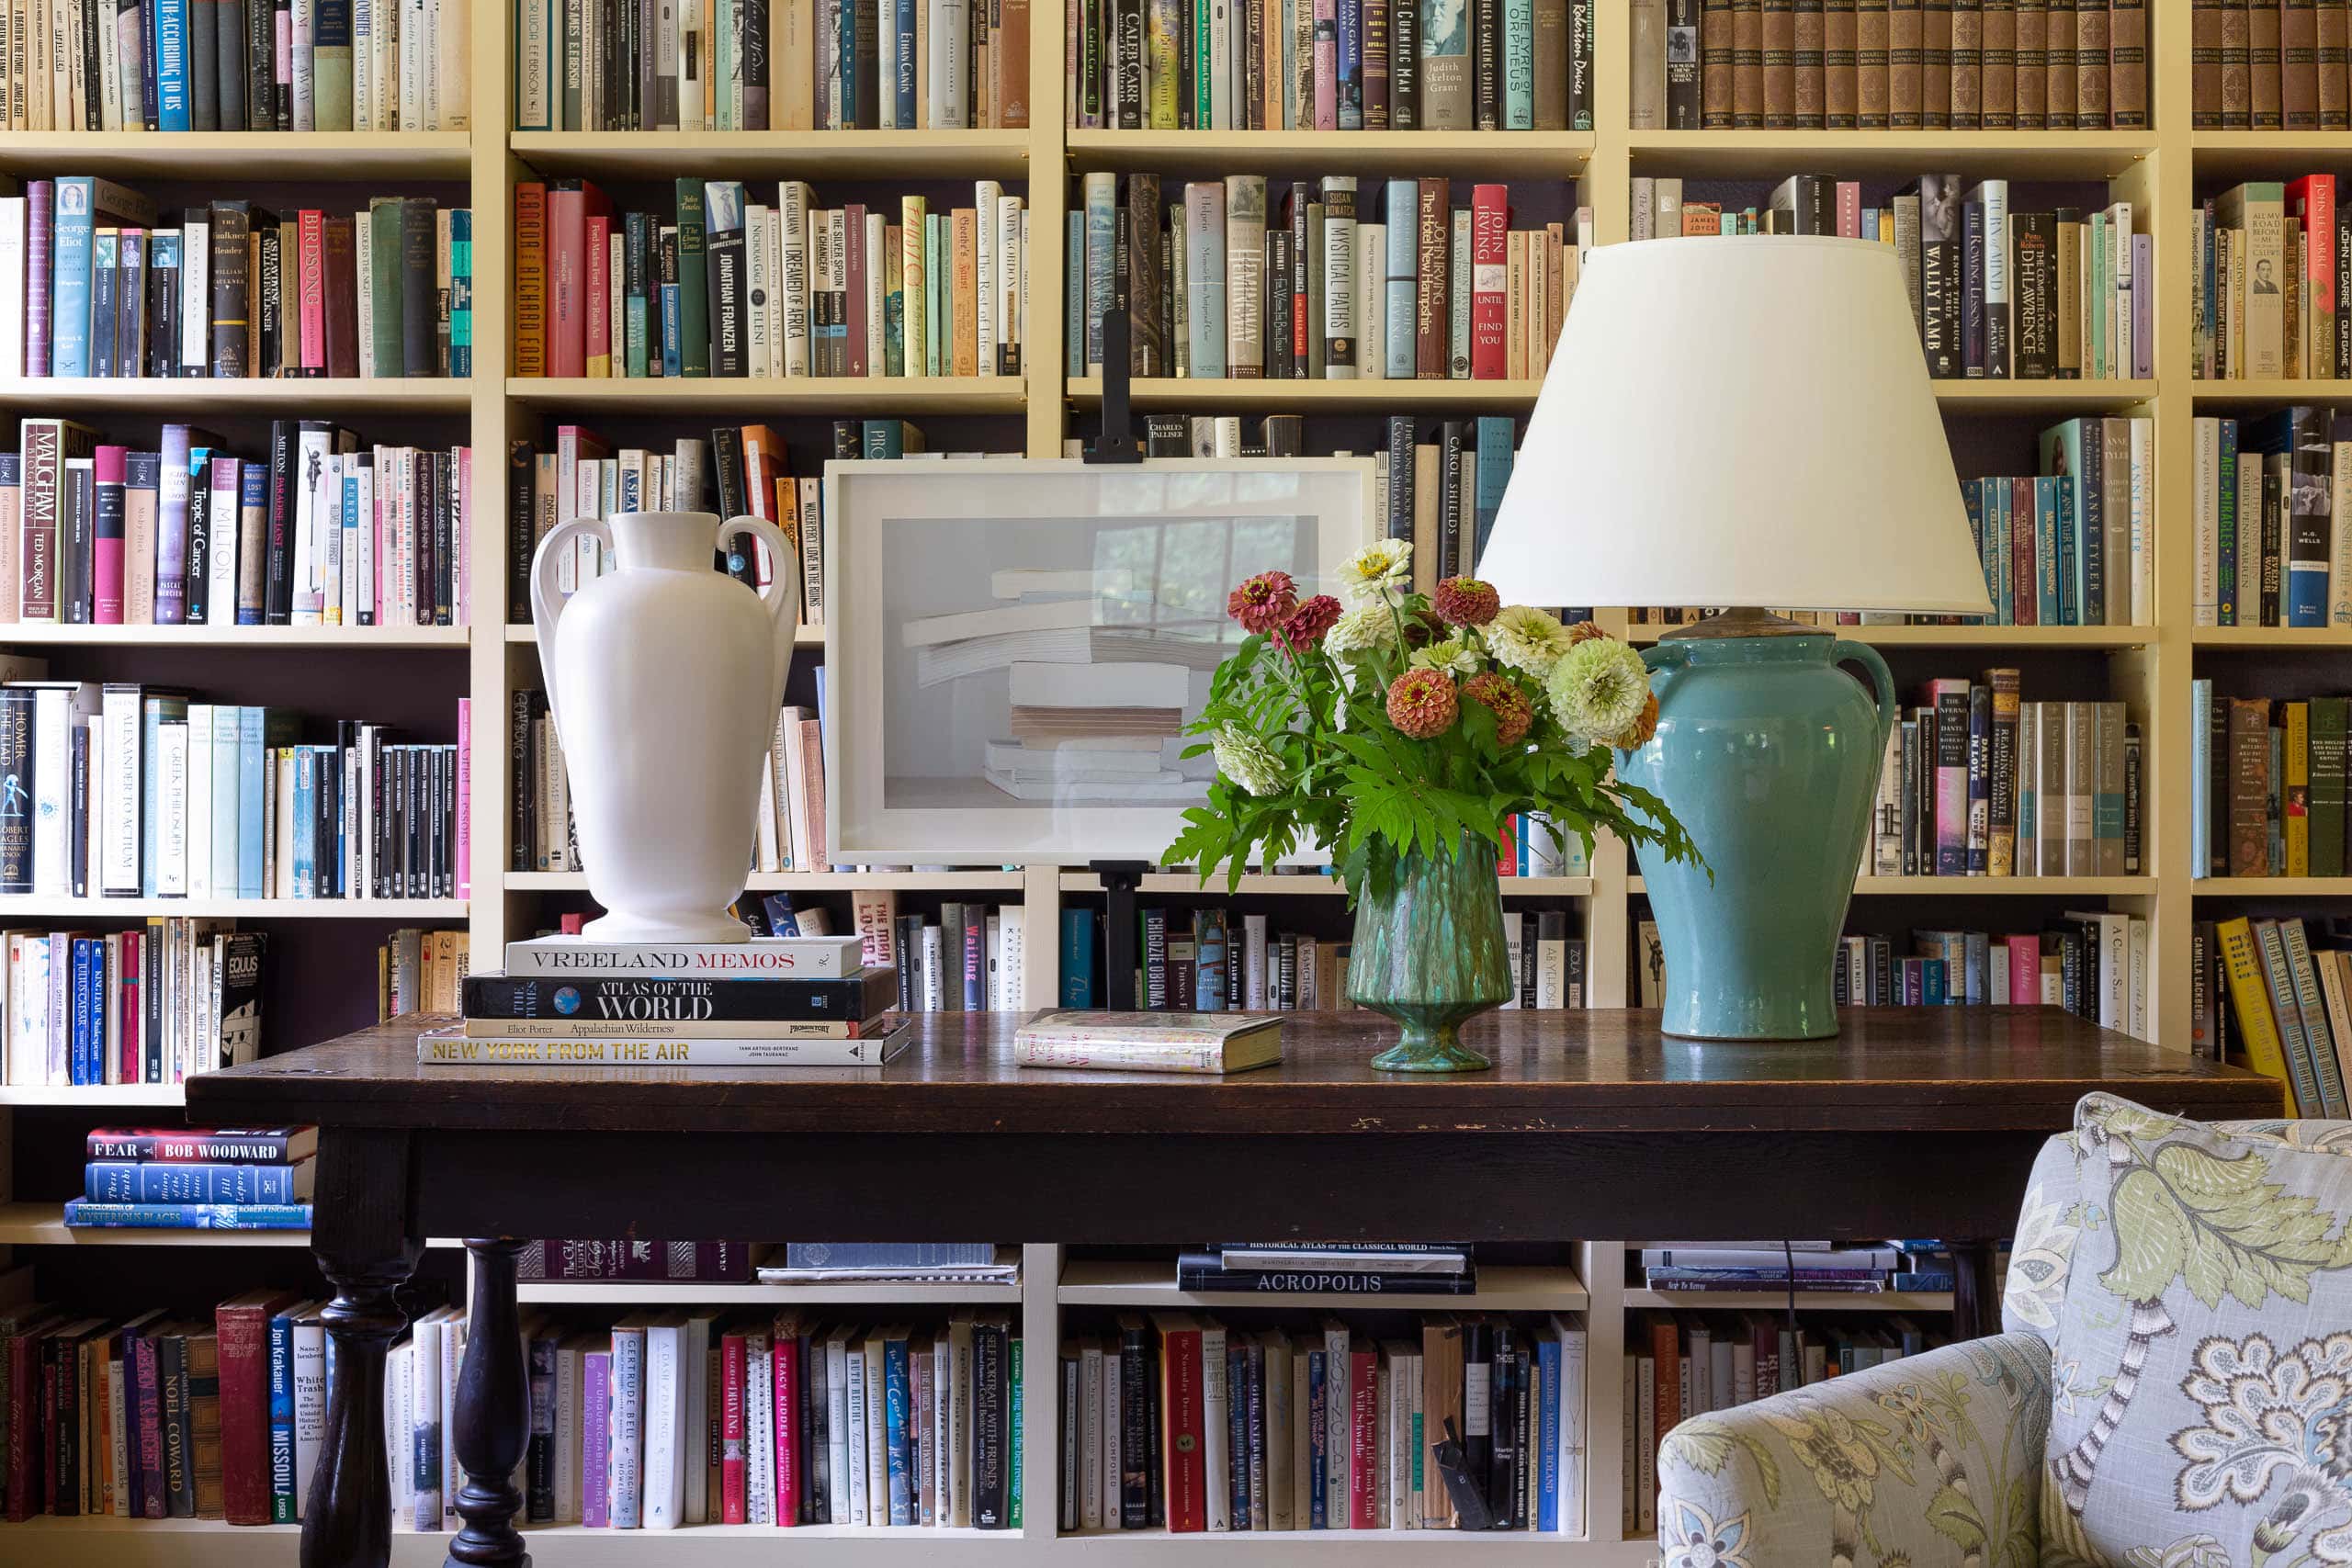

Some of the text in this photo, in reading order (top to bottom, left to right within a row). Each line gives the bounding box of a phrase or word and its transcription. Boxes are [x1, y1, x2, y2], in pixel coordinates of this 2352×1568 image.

[161, 15, 182, 110] ACCORDING TO US
[1126, 13, 1140, 103] CALEB CARR
[1397, 11, 1413, 93] CUNNING MAN
[1429, 62, 1458, 73] Judith
[1510, 7, 1520, 92] ORPHEUS
[1521, 4, 1531, 99] THE LYRE OF
[1574, 4, 1587, 95] Robertson Davies
[1427, 73, 1462, 83] Skelton
[1430, 83, 1458, 93] Grant
[786, 186, 797, 200] KUKI
[786, 202, 799, 235] GALLMANN
[1477, 206, 1490, 260] IRVING
[1492, 211, 1503, 253] JOHN
[2341, 226, 2349, 257] JOHN
[303, 213, 320, 305] BIRDSONG
[786, 250, 803, 292] DREAMED
[1330, 228, 1349, 329] MYSTICAL PATHS
[1419, 191, 1435, 334] The Hotel New Hampshire
[1433, 222, 1445, 305] JOHN IRVING
[2341, 260, 2346, 269] LE
[720, 254, 735, 352] JONATHAN FRANZEN
[752, 225, 764, 345] NICHOLAS GAGE ELENI
[787, 296, 802, 306] OF
[1477, 296, 1503, 305] UNTIL
[1927, 245, 1940, 349] WALLY LAMB
[787, 307, 803, 338] AFRICA
[1478, 323, 1503, 332] FIND
[1479, 336, 1500, 345] YOU
[2341, 320, 2349, 340] OUR
[37, 432, 55, 521] MAUGHAM
[277, 435, 287, 473] MILTON
[26, 448, 35, 520] BIOGRAPHY
[276, 478, 285, 522] PARADISE
[1448, 436, 1459, 535] CAROL SHIELDS
[191, 487, 206, 579] Tropic of Cancer
[215, 507, 232, 581] MILTON
[805, 502, 821, 606] WALKER PERCY LOVE IN THE RUINS
[2088, 491, 2099, 592] ANNE TYLER
[28, 533, 44, 599] TED MORGAN
[0, 706, 12, 766] THE ILIAD
[15, 711, 27, 759] HOMER
[1970, 735, 1979, 781] IN LOVE
[531, 953, 796, 969] VREELAND MEMOS
[965, 925, 979, 981] Waiting
[1148, 917, 1163, 963] CHIGOZIE
[229, 959, 259, 972] EQUUS
[596, 982, 713, 996] ATLAS OF THE
[2194, 937, 2204, 1020] CAMILLA LÄCKBERG
[93, 970, 102, 1062] KING LEAR Shakespeare
[514, 987, 524, 1014] THE
[527, 981, 537, 1018] TIMES
[596, 997, 713, 1020] WORLD
[2288, 930, 2338, 1099] SUGAR STREET NAGUIB MAHFOUZ
[433, 1043, 689, 1060] NEW YORK FROM THE AIR
[507, 1023, 831, 1036] Eliot Porter Appalachian Wilderness PROMONTORY
[95, 1143, 277, 1159] FEAR BOB WOODWARD
[221, 1178, 230, 1195] Jill
[236, 1170, 244, 1203] Lepore
[1257, 1275, 1382, 1292] ACROPOLIS
[272, 1328, 285, 1394] Jon Krakauer
[296, 1376, 324, 1385] White
[626, 1339, 636, 1440] GERTRUDE BELL
[779, 1356, 788, 1438] TRACY KIDDER
[165, 1376, 182, 1492] NOEL COWARD
[1251, 1385, 1262, 1497] GIRL, INTERRUPTED
[1545, 1361, 1555, 1494] MEMOIRS MADAME ROLAND
[278, 1499, 287, 1518] USED
